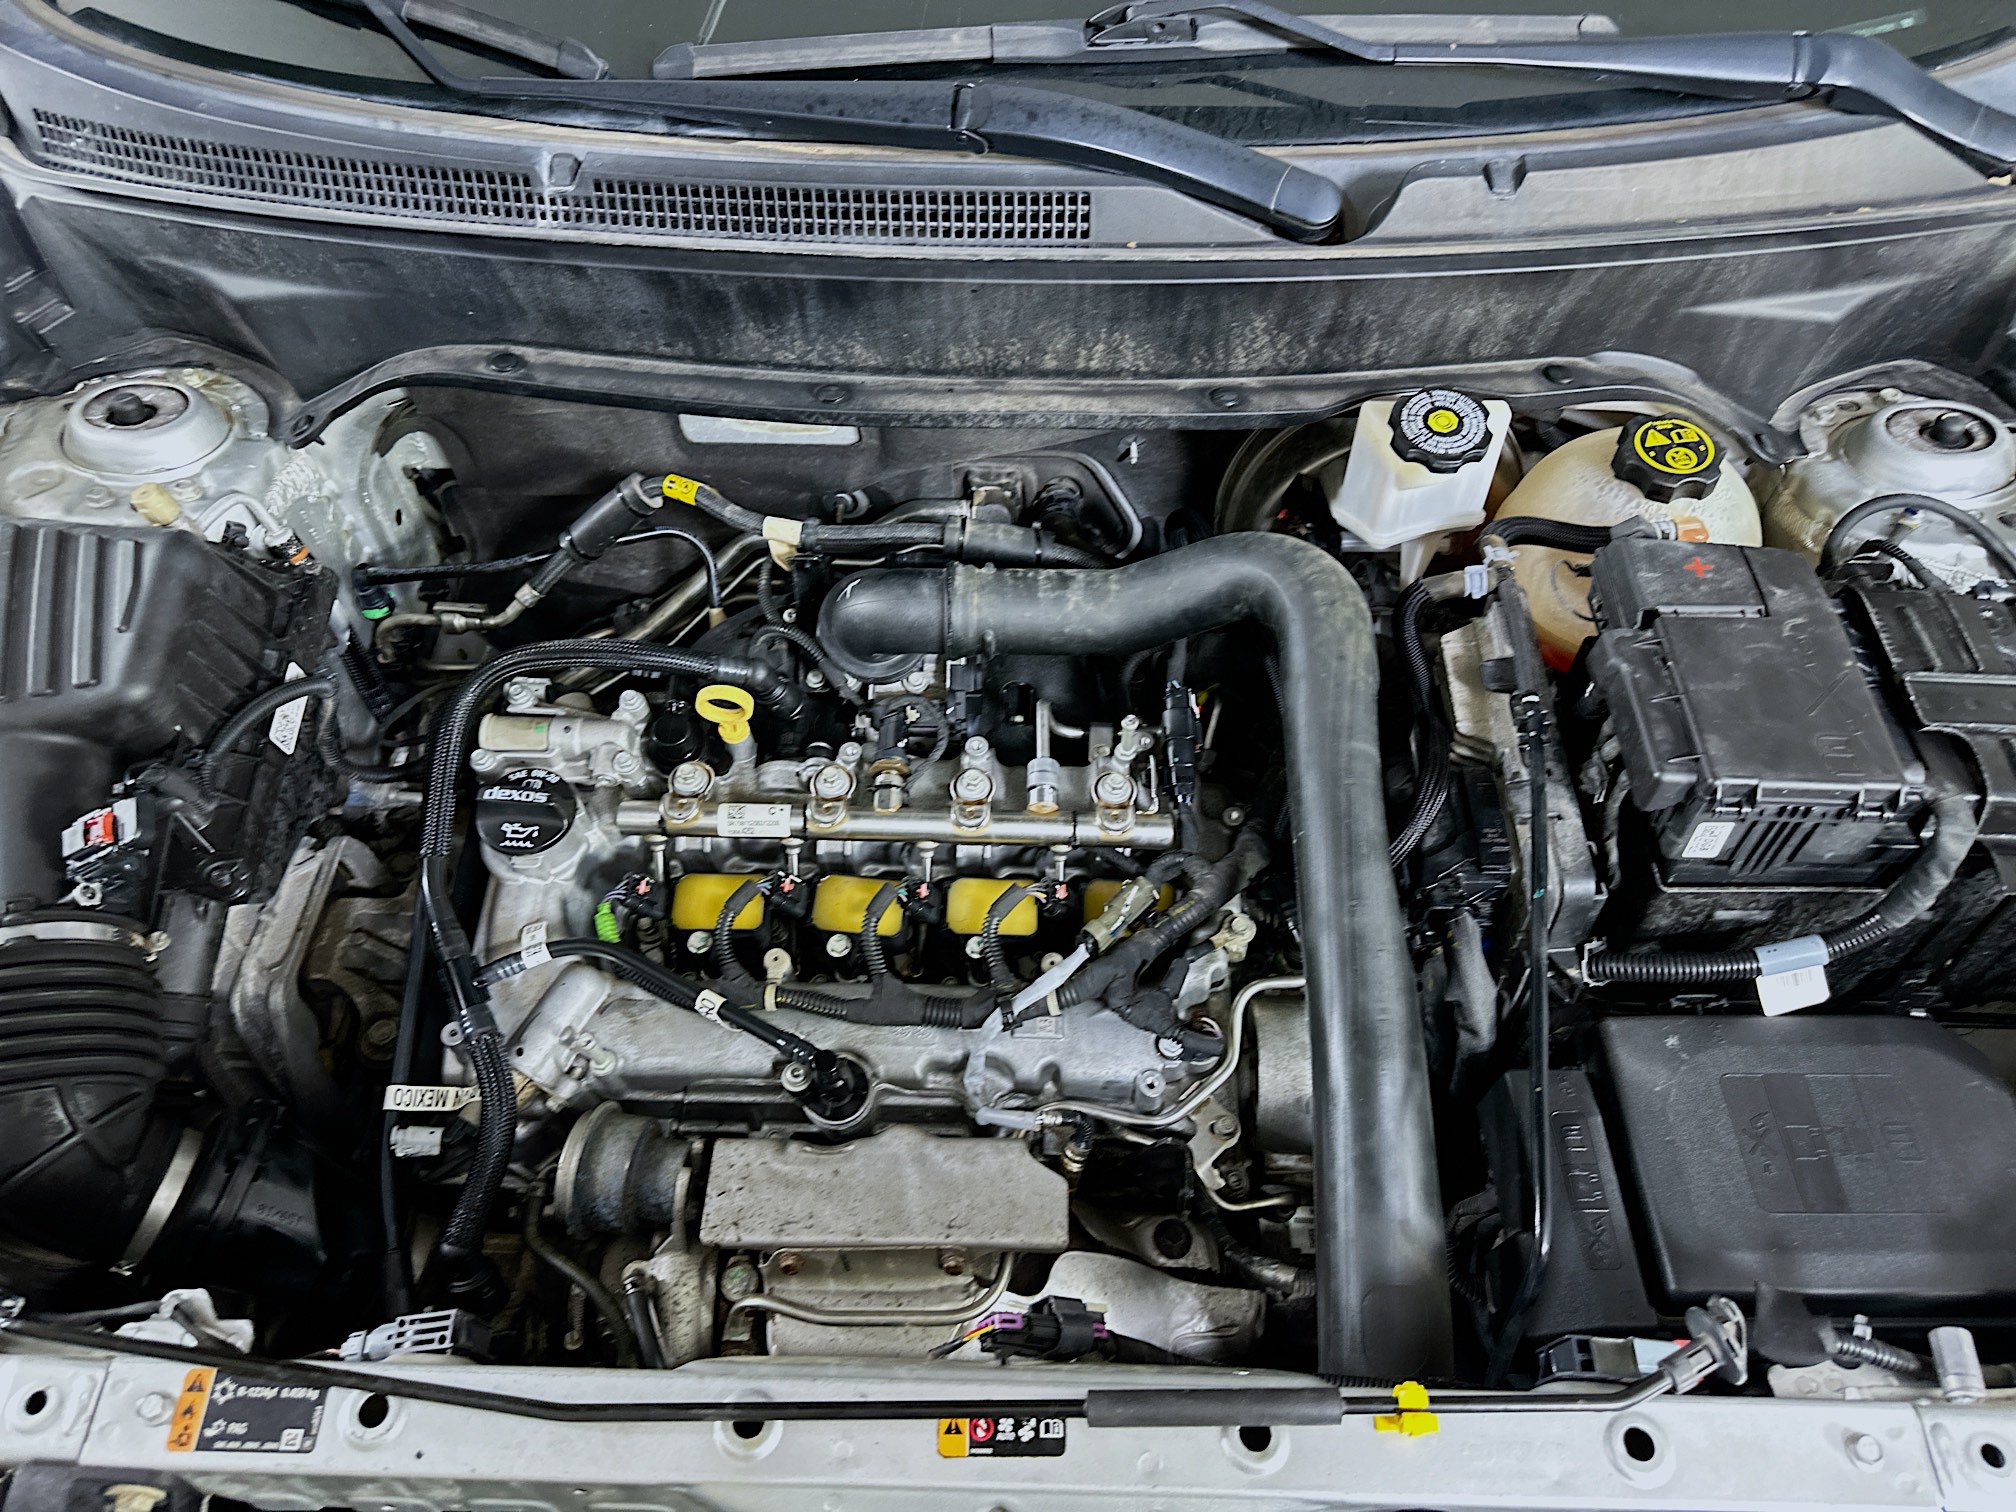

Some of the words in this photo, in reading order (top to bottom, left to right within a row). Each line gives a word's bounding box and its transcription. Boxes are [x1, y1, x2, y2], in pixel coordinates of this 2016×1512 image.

[508, 769, 529, 781] SAE
[483, 786, 551, 803] dexos
[394, 1088, 450, 1108] MEXICO
